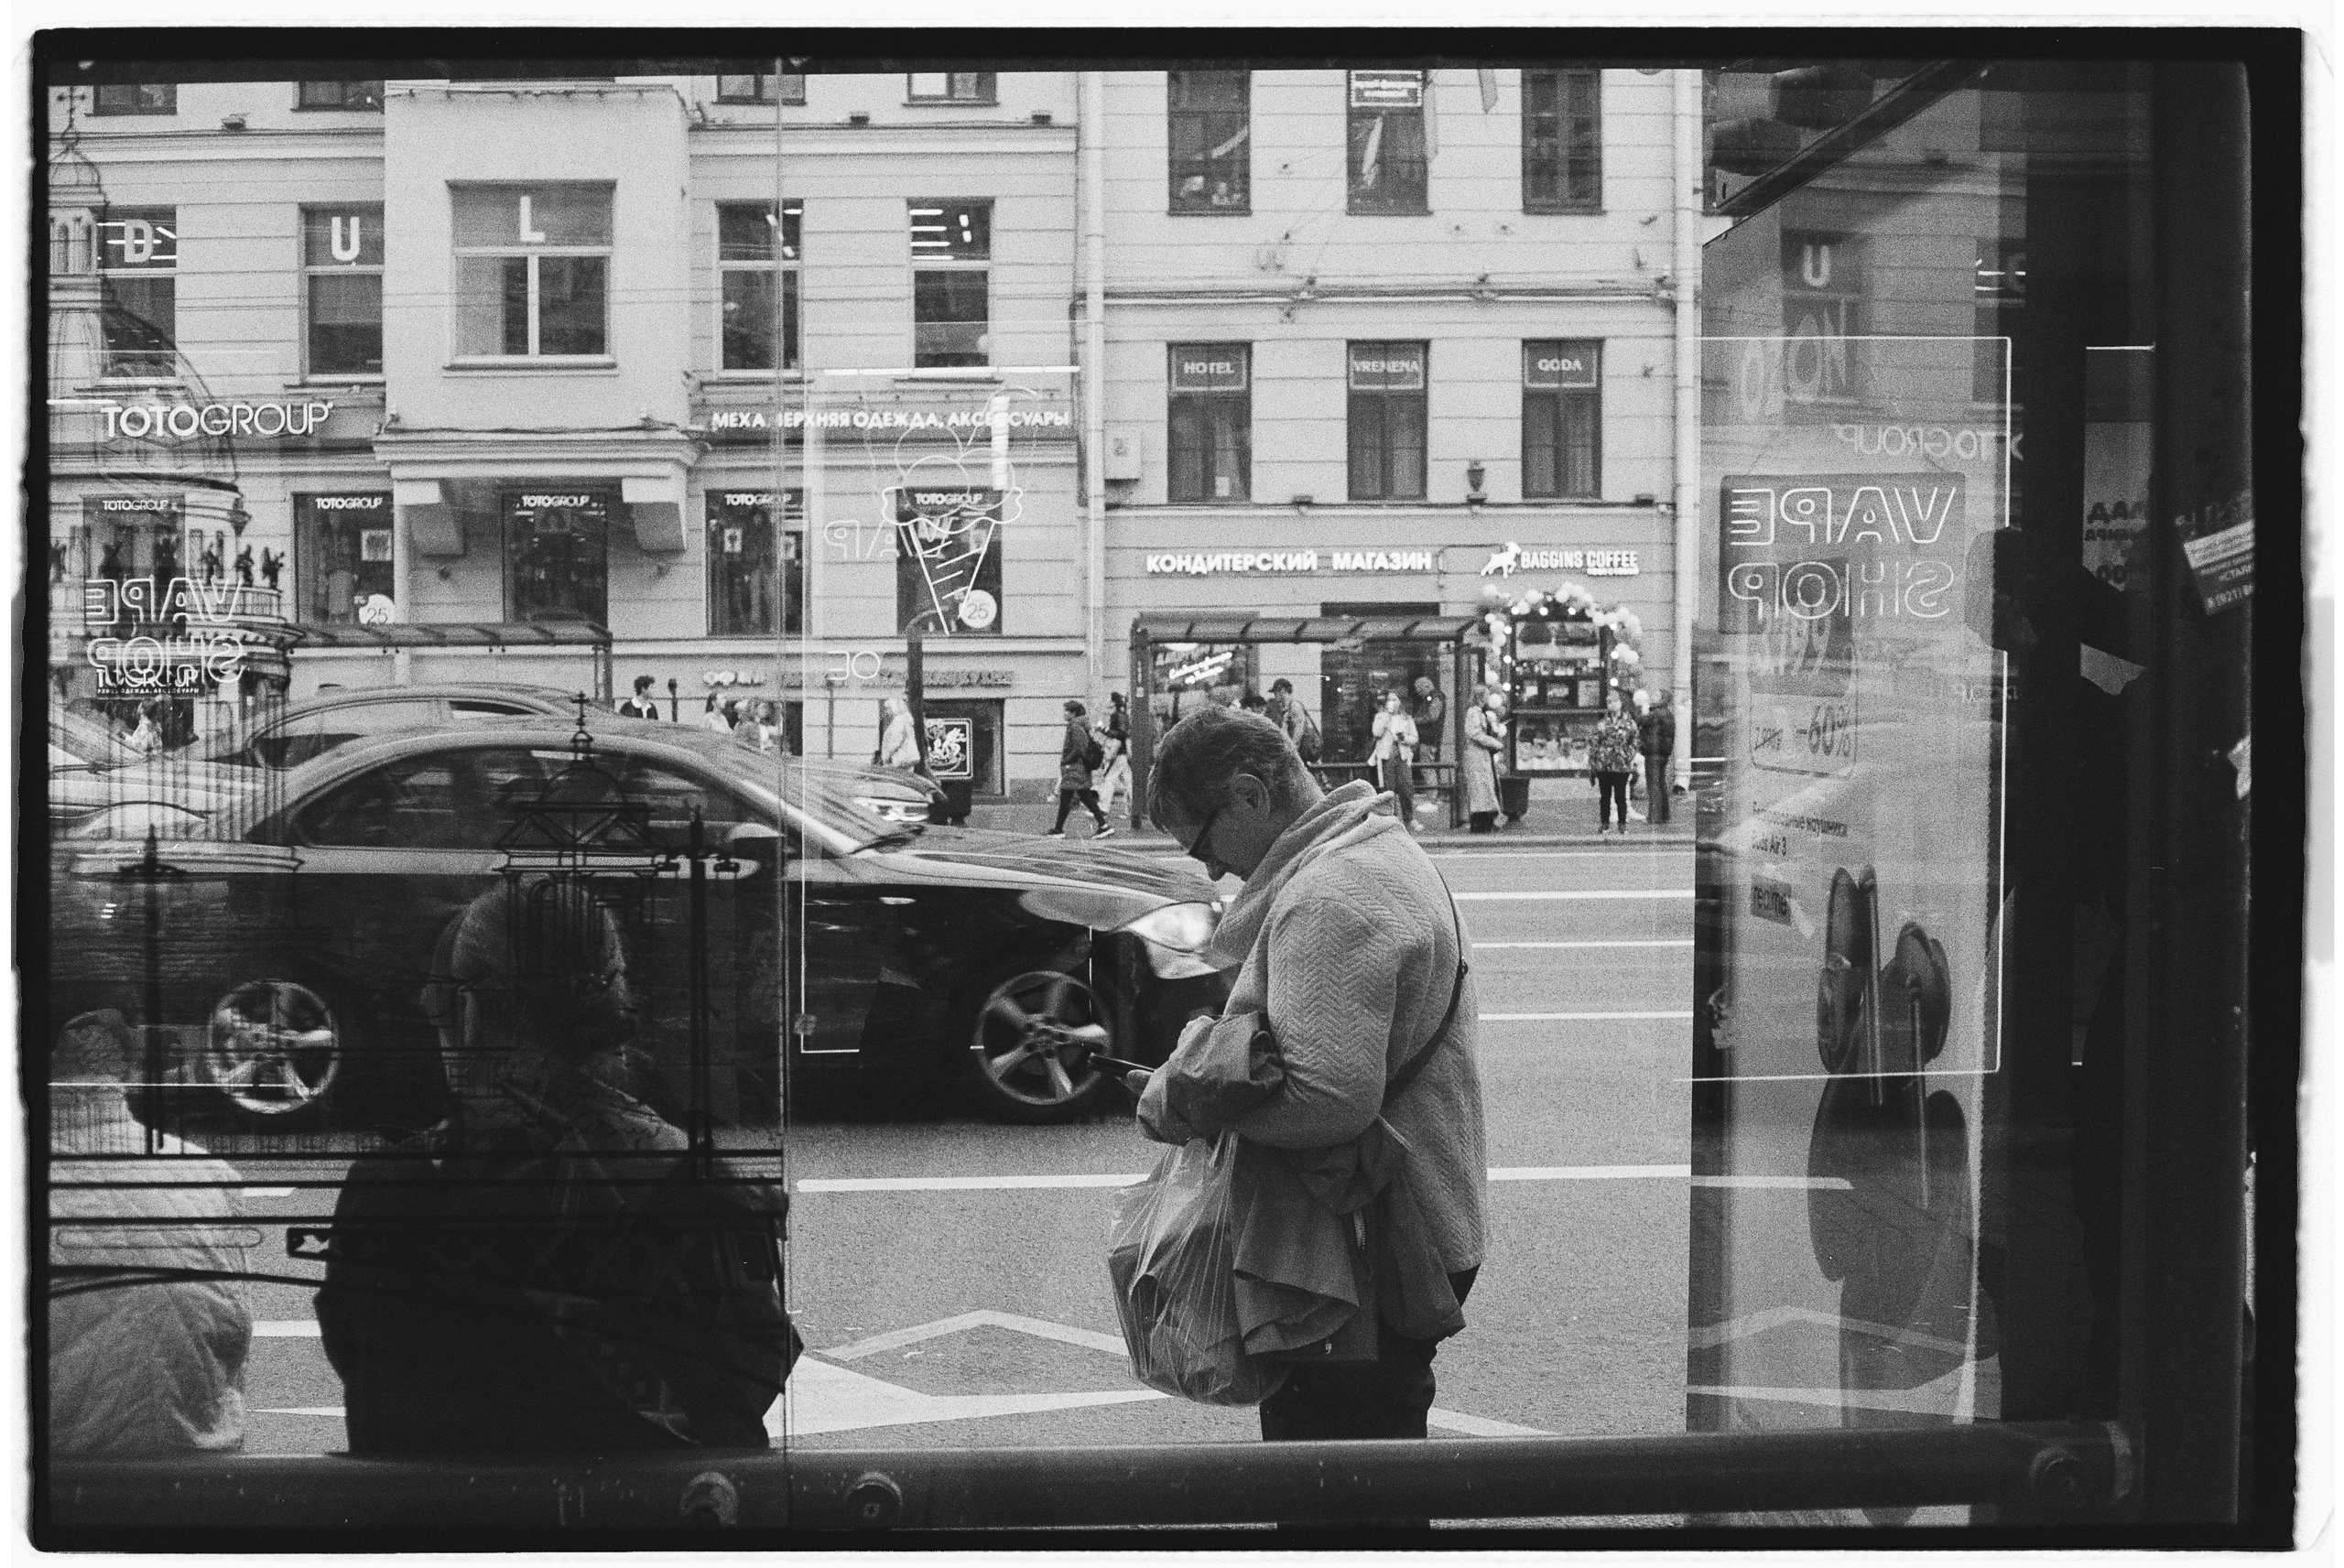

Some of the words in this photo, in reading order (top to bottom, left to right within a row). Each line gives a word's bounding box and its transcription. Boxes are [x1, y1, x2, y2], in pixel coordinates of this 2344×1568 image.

[331, 216, 361, 262] U
[519, 195, 546, 243] L
[1183, 361, 1235, 376] HOTEL
[1537, 359, 1583, 372] GODA
[100, 402, 330, 438] TOTOGROUP
[947, 412, 1069, 427] АКСЕСУАРЫ
[315, 497, 383, 509] TOTOGROUP
[1146, 549, 1318, 575] КОНДИТЕРСКИЙ
[1332, 551, 1433, 571] МАГАЗИН
[1520, 550, 1584, 569] BAGGINS
[1586, 550, 1637, 568] COFFEE
